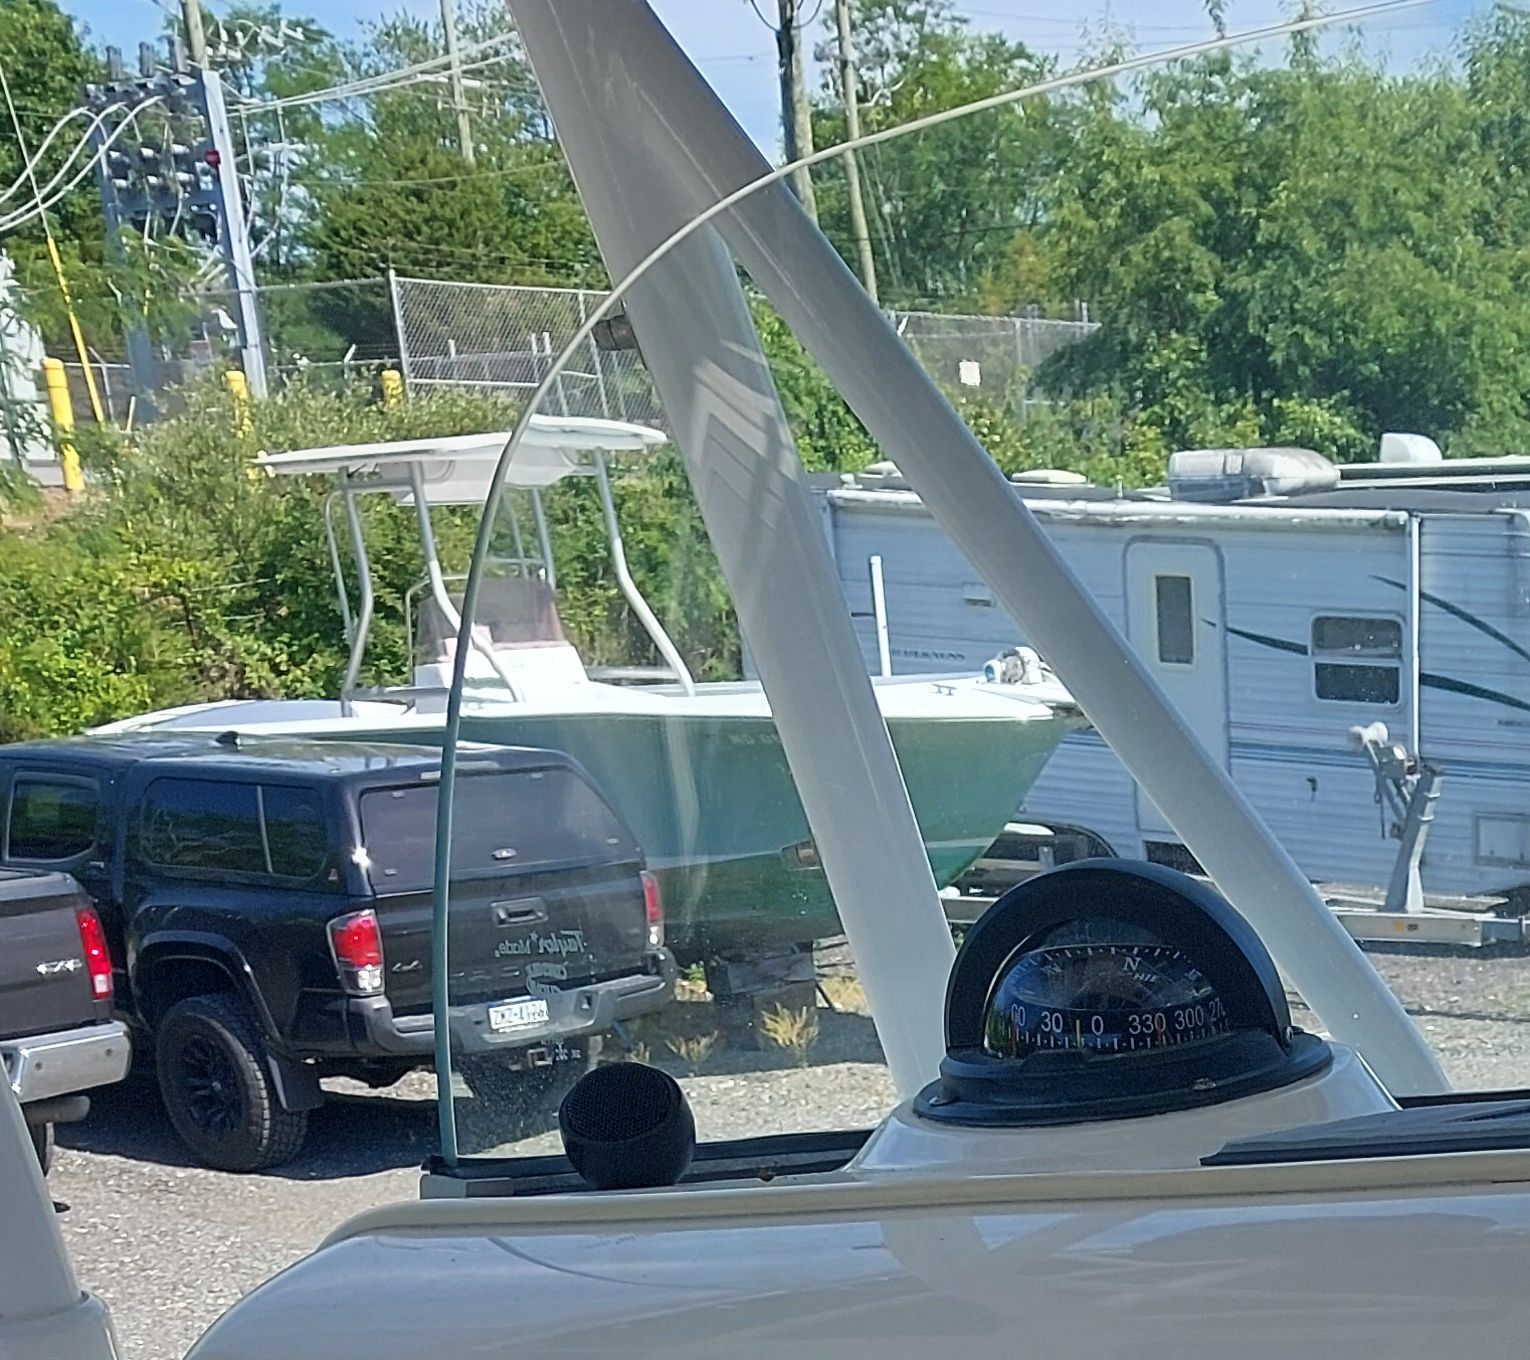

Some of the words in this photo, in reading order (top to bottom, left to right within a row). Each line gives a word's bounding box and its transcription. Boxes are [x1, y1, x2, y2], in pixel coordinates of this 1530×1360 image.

[1122, 957, 1142, 971] N
[1040, 1011, 1063, 1033] 30
[1091, 1015, 1104, 1035] 0
[1129, 1012, 1166, 1035] 330
[1174, 1007, 1204, 1030] 300
